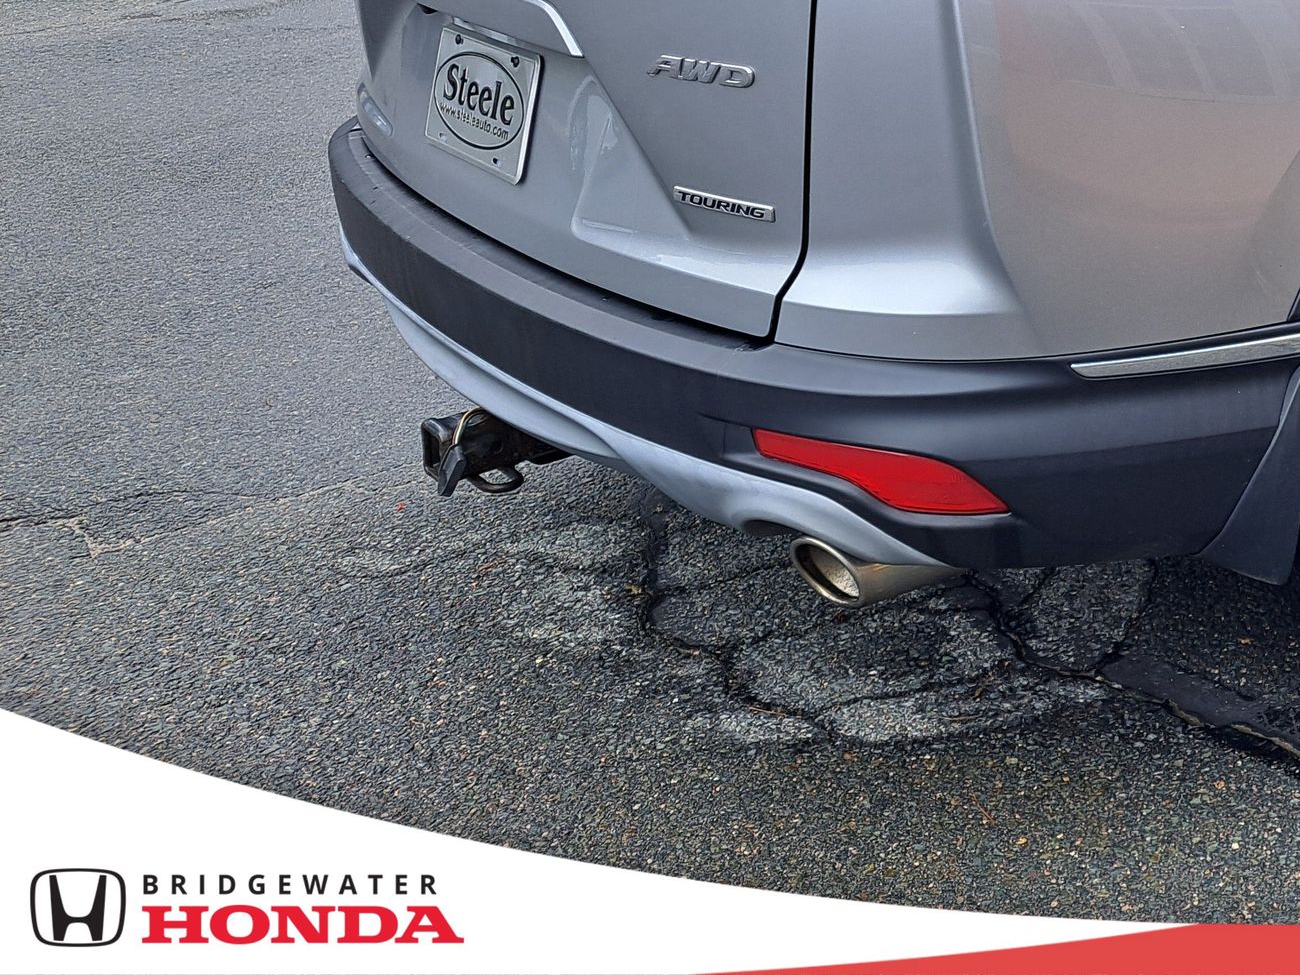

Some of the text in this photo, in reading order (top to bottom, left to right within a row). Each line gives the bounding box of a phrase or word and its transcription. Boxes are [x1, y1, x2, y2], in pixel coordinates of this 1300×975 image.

[647, 54, 756, 89] AWD
[443, 63, 515, 126] Steele
[439, 101, 509, 141] www.steeleauto.com
[678, 190, 765, 219] TOURING
